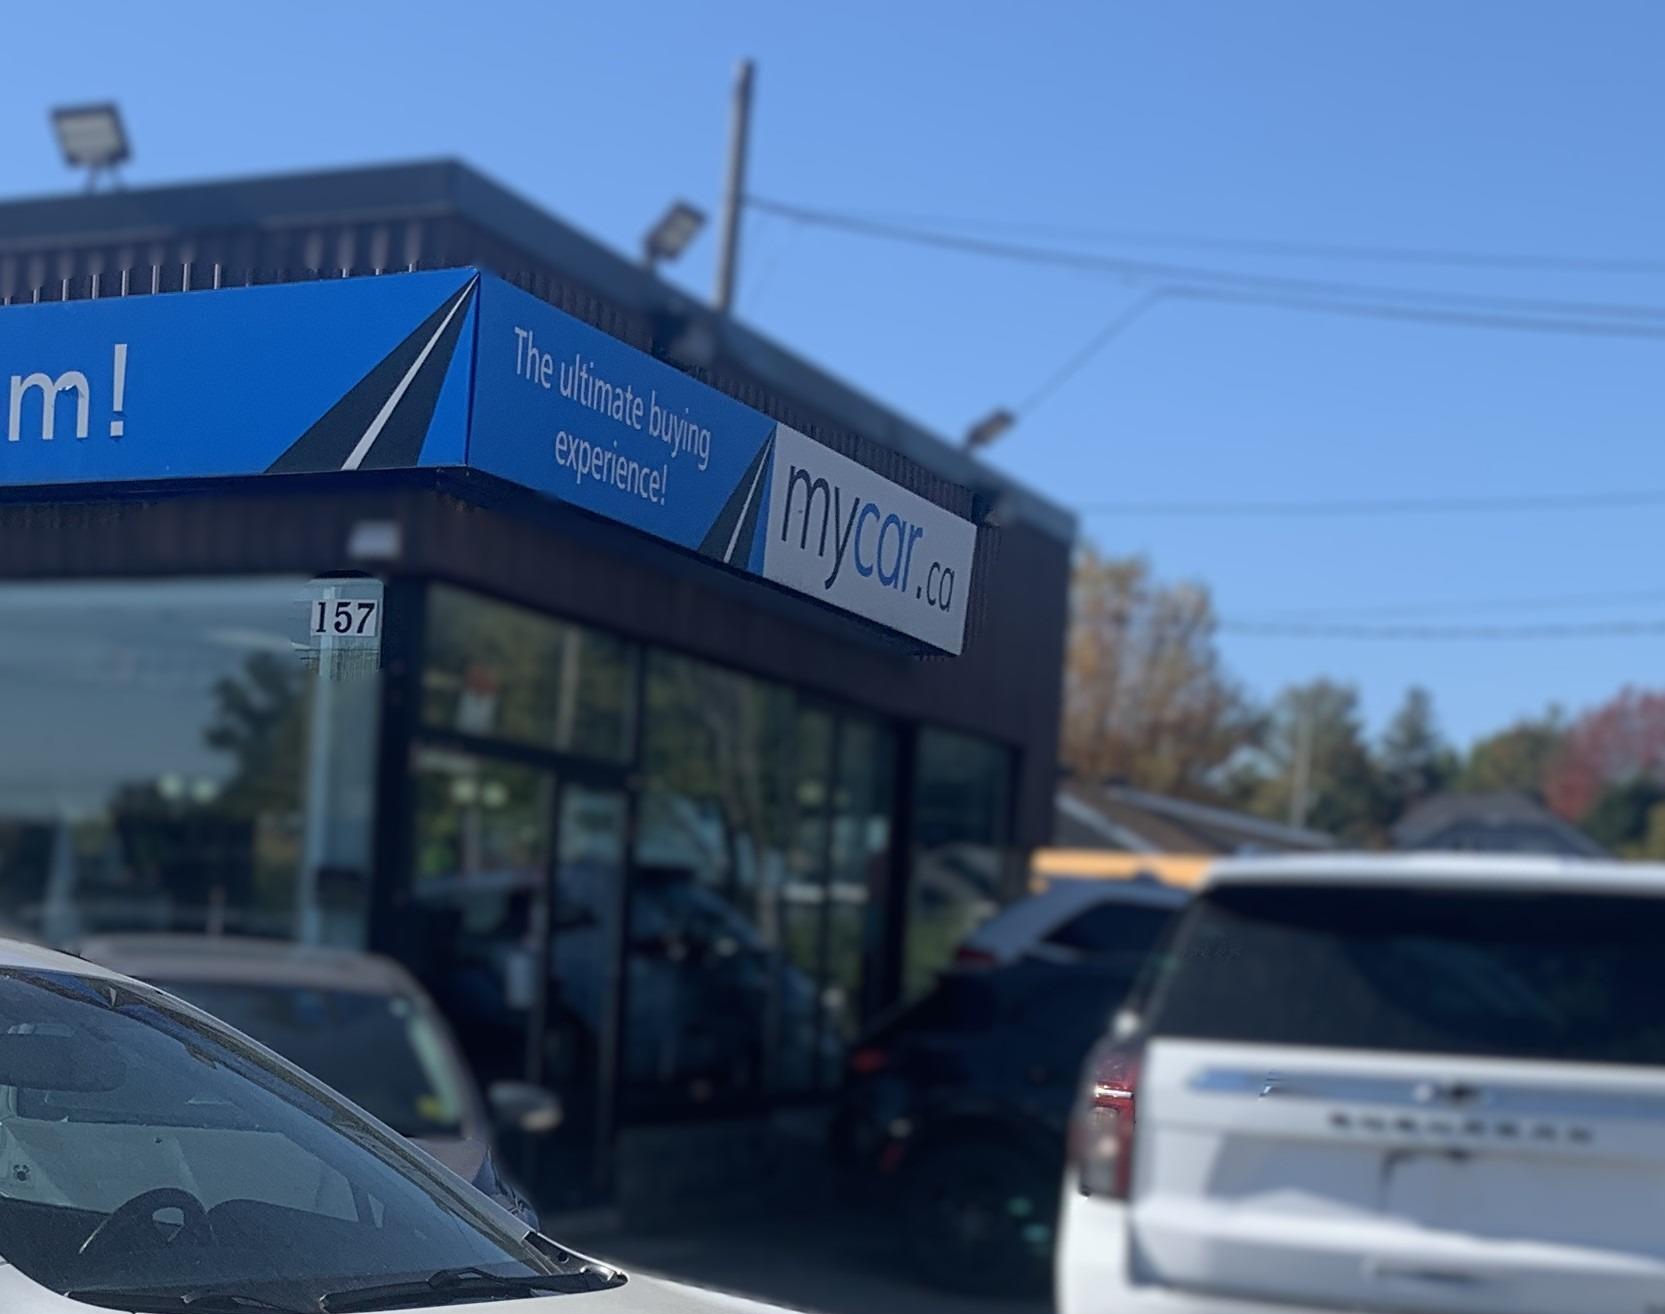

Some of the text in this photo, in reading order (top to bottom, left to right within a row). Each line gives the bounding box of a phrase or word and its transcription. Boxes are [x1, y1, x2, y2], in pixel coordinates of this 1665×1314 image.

[514, 326, 711, 472] The ultimate buying
[555, 431, 668, 506] experience!
[781, 465, 955, 613] mycar.ca
[315, 601, 376, 634] 157
